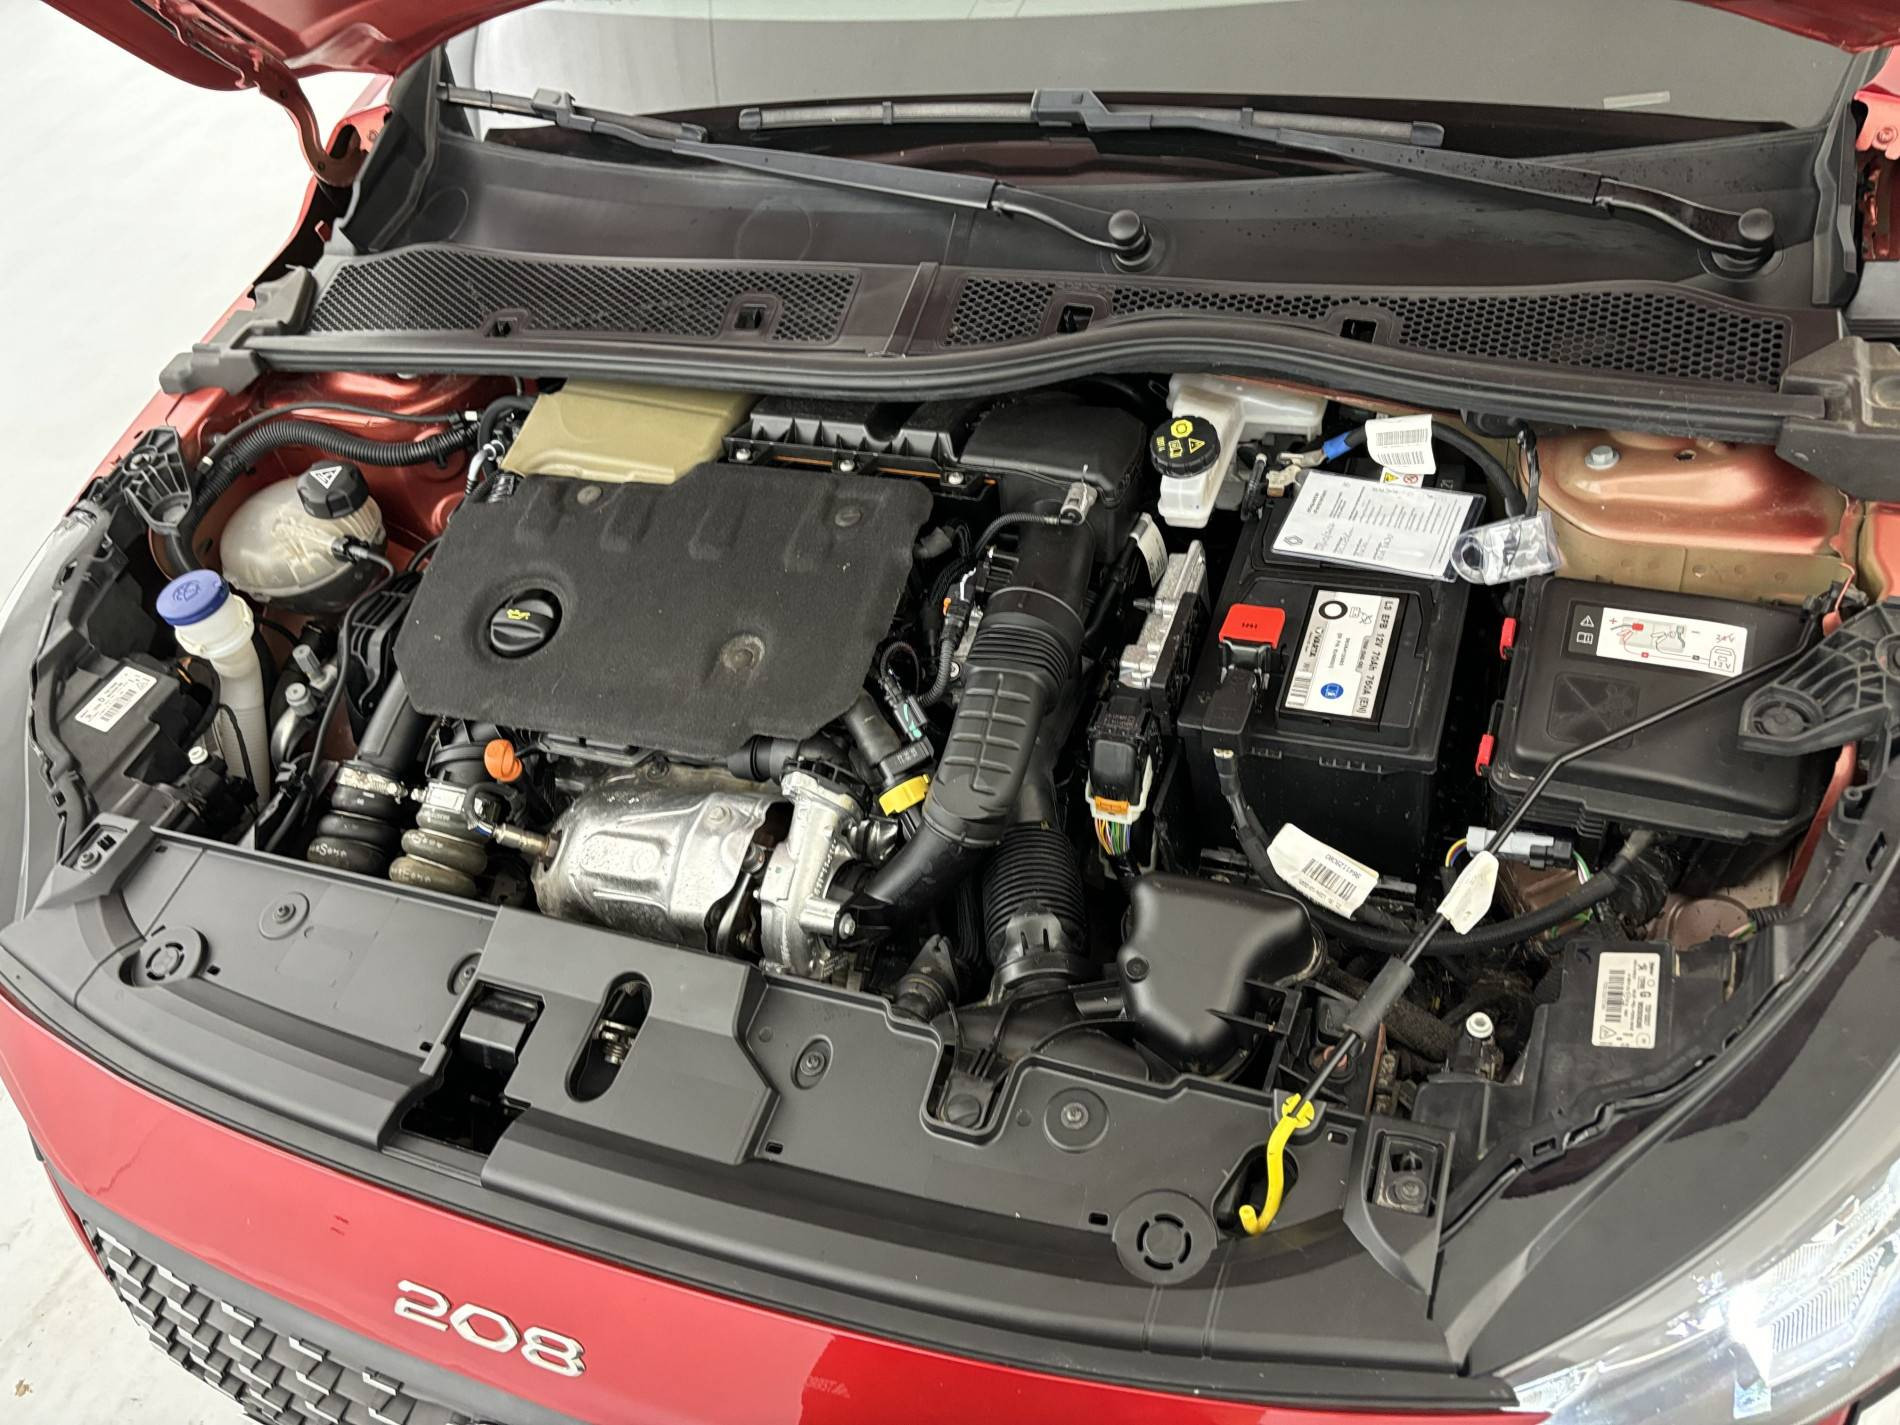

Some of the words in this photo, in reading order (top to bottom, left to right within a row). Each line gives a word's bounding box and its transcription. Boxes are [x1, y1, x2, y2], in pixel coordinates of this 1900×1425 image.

[1378, 613, 1390, 629] EFB
[1373, 632, 1385, 647] 12V
[394, 1279, 587, 1378] 208
